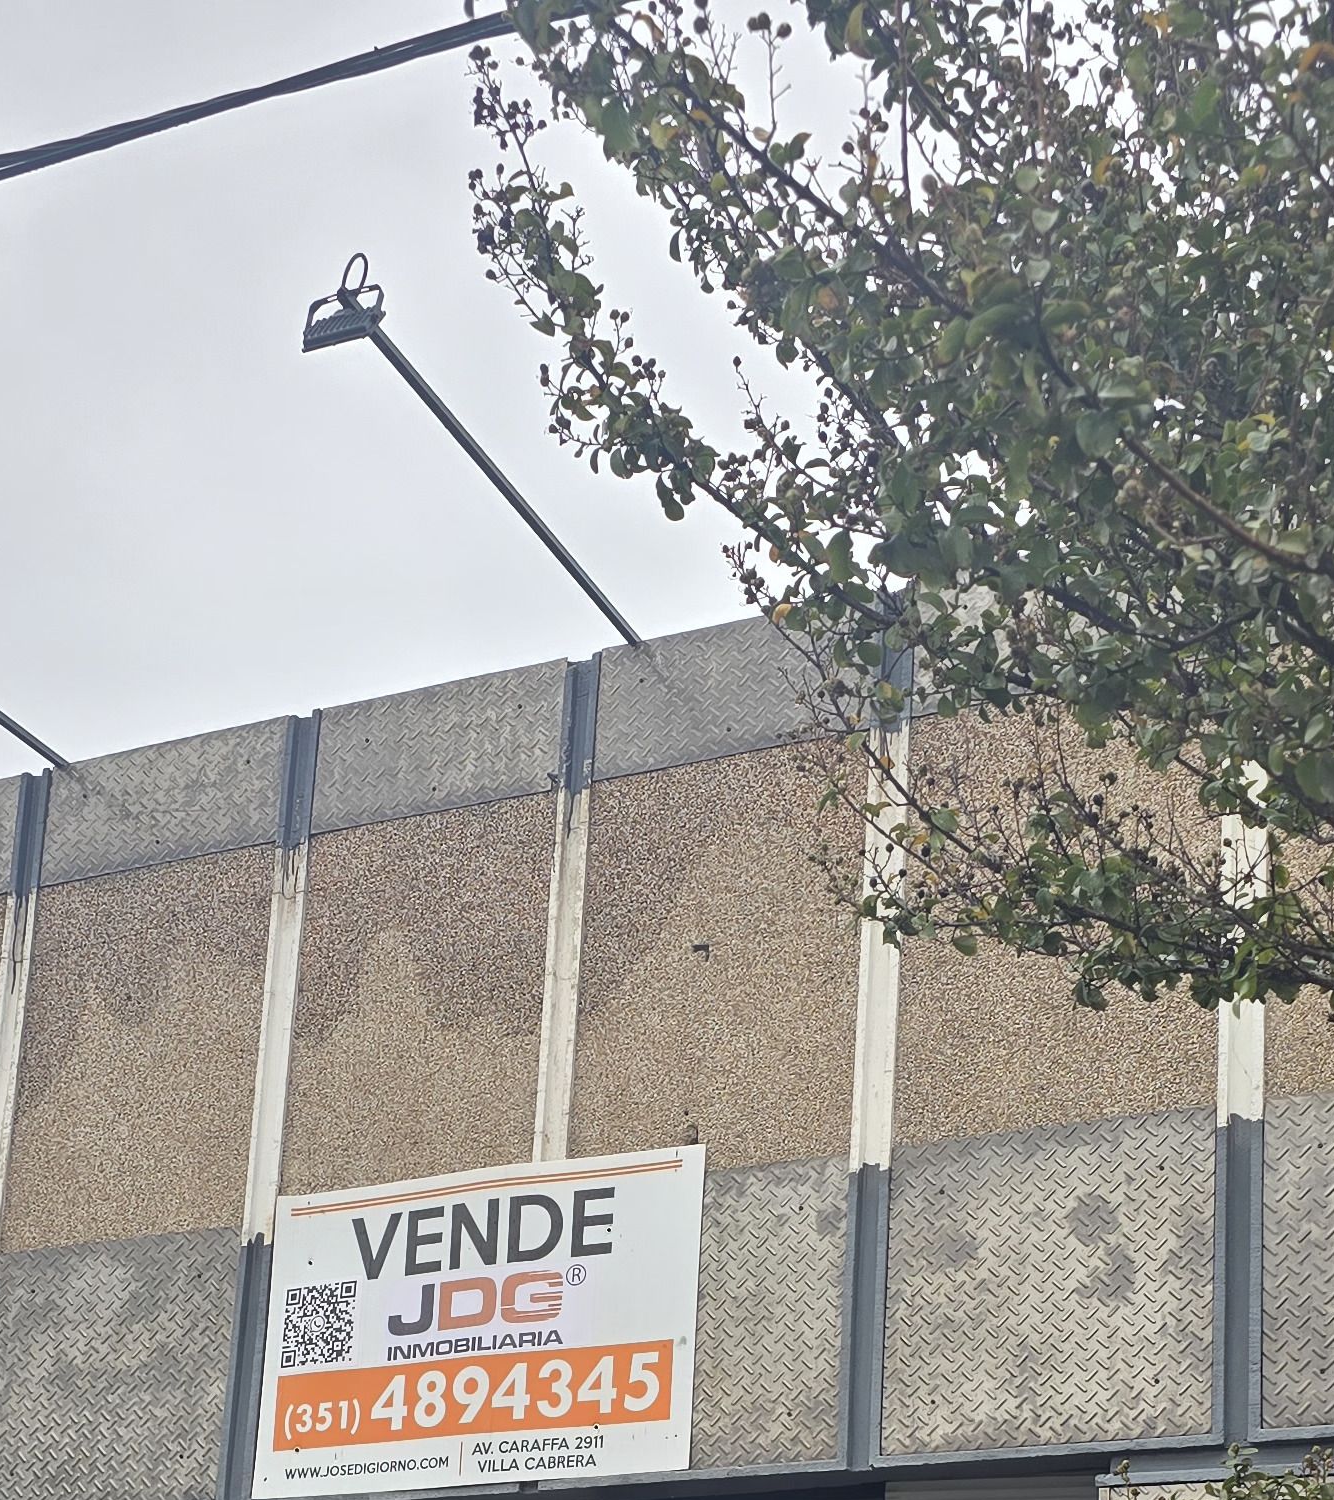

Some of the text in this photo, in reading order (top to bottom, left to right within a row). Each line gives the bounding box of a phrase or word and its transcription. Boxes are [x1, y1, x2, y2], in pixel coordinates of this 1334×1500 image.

[352, 1187, 616, 1280] VENDE
[387, 1269, 564, 1336] JDG
[387, 1329, 563, 1361] INMOBILIARIA
[283, 1351, 660, 1440] (351) 4894345
[471, 1435, 604, 1456] AV. CARAFFA 2911
[284, 1455, 450, 1480] WWW.JOSEDIGIORNO.COM
[477, 1454, 597, 1473] VILLA CABRERA
